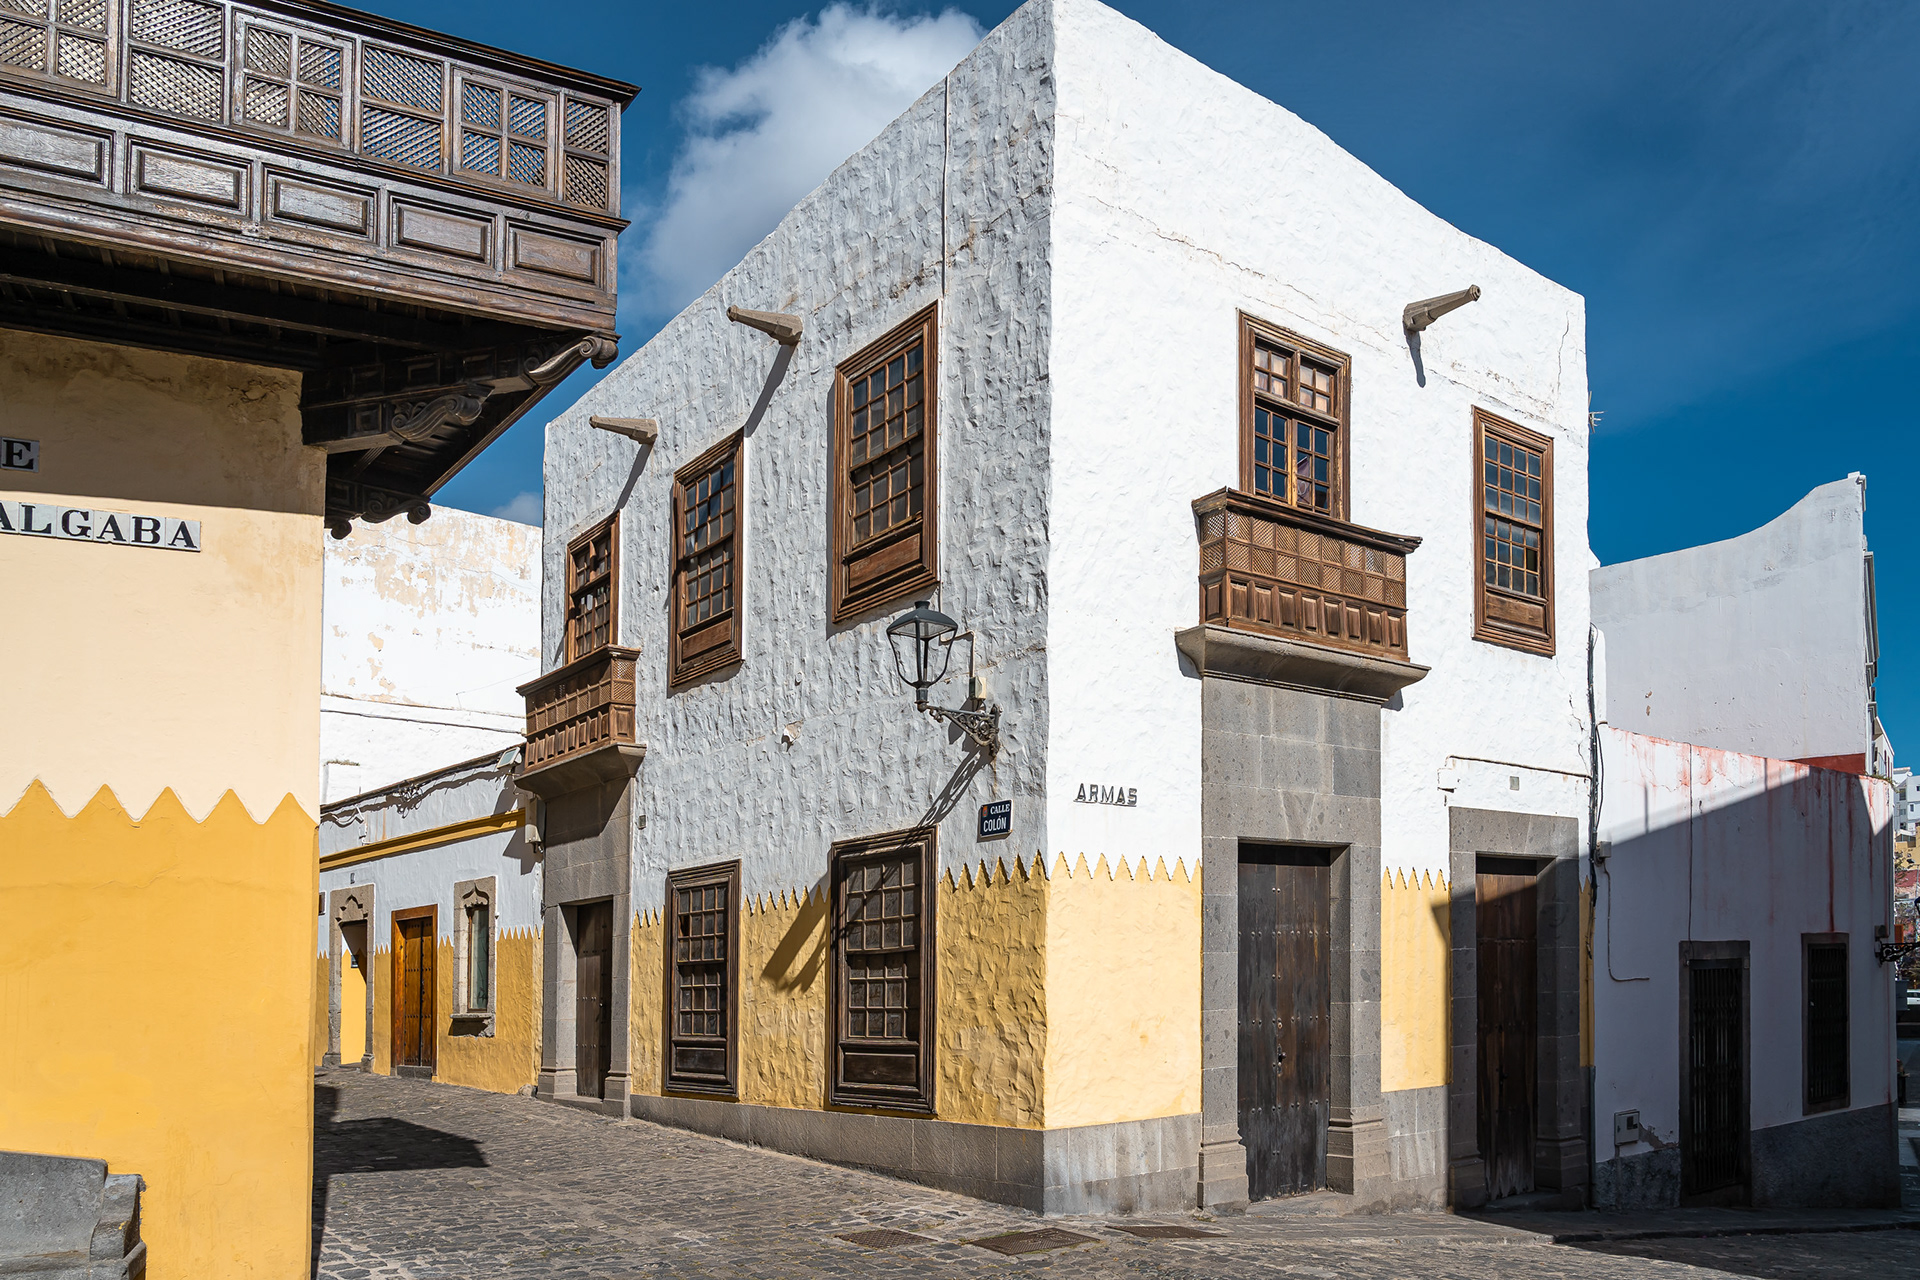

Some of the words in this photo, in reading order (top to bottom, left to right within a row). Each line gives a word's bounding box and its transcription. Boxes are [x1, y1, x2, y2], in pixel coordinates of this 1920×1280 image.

[1074, 782, 1138, 805] ARMAS
[990, 803, 1011, 815] CALLE
[983, 815, 1007, 832] COLÓN
